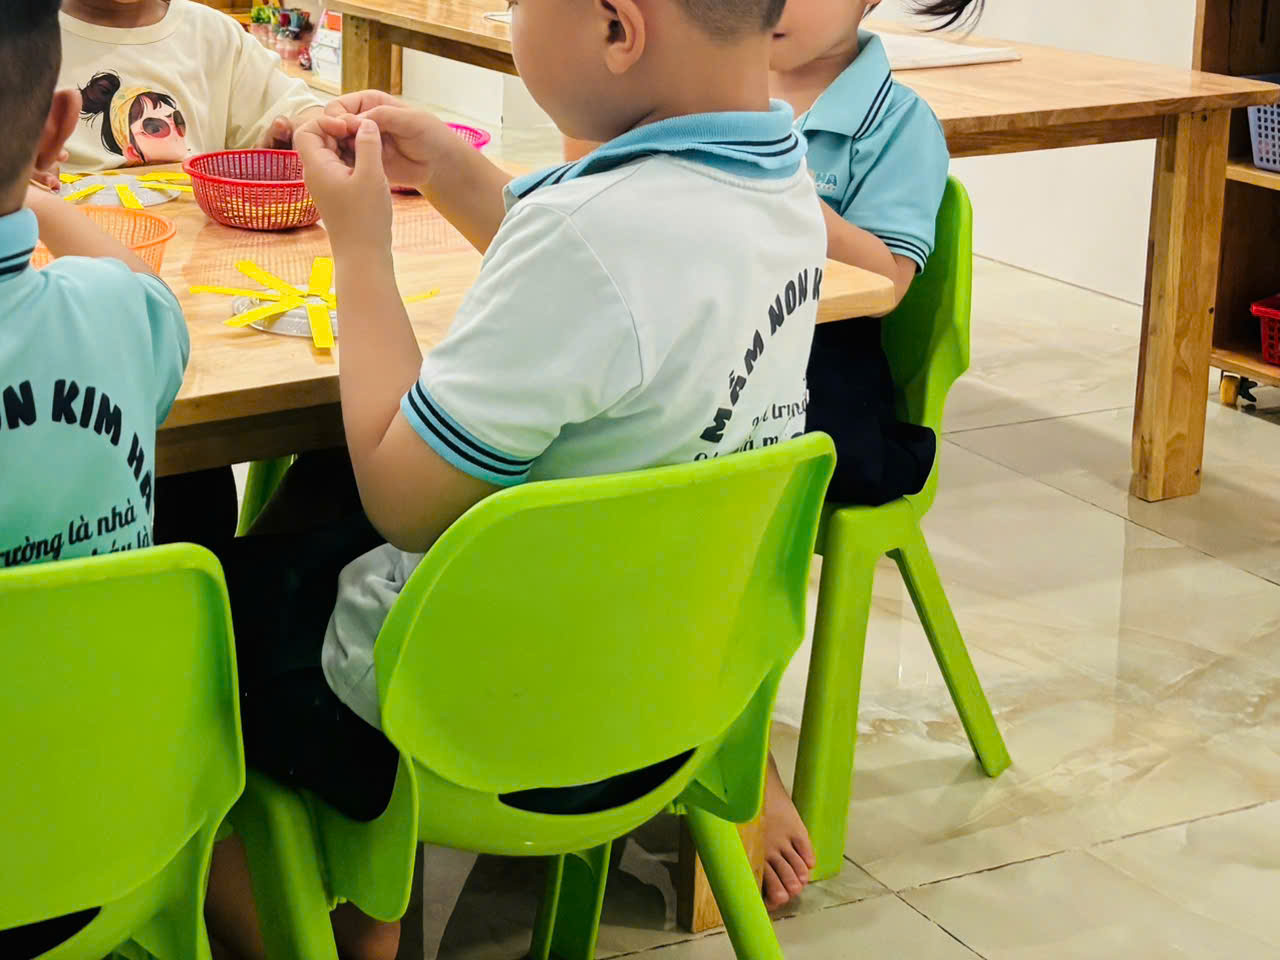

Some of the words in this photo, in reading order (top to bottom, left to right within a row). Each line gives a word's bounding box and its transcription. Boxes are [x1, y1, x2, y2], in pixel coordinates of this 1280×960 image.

[768, 268, 808, 336] NON
[51, 379, 122, 446] KIM
[67, 515, 94, 545] là
[97, 498, 138, 536] nhà
